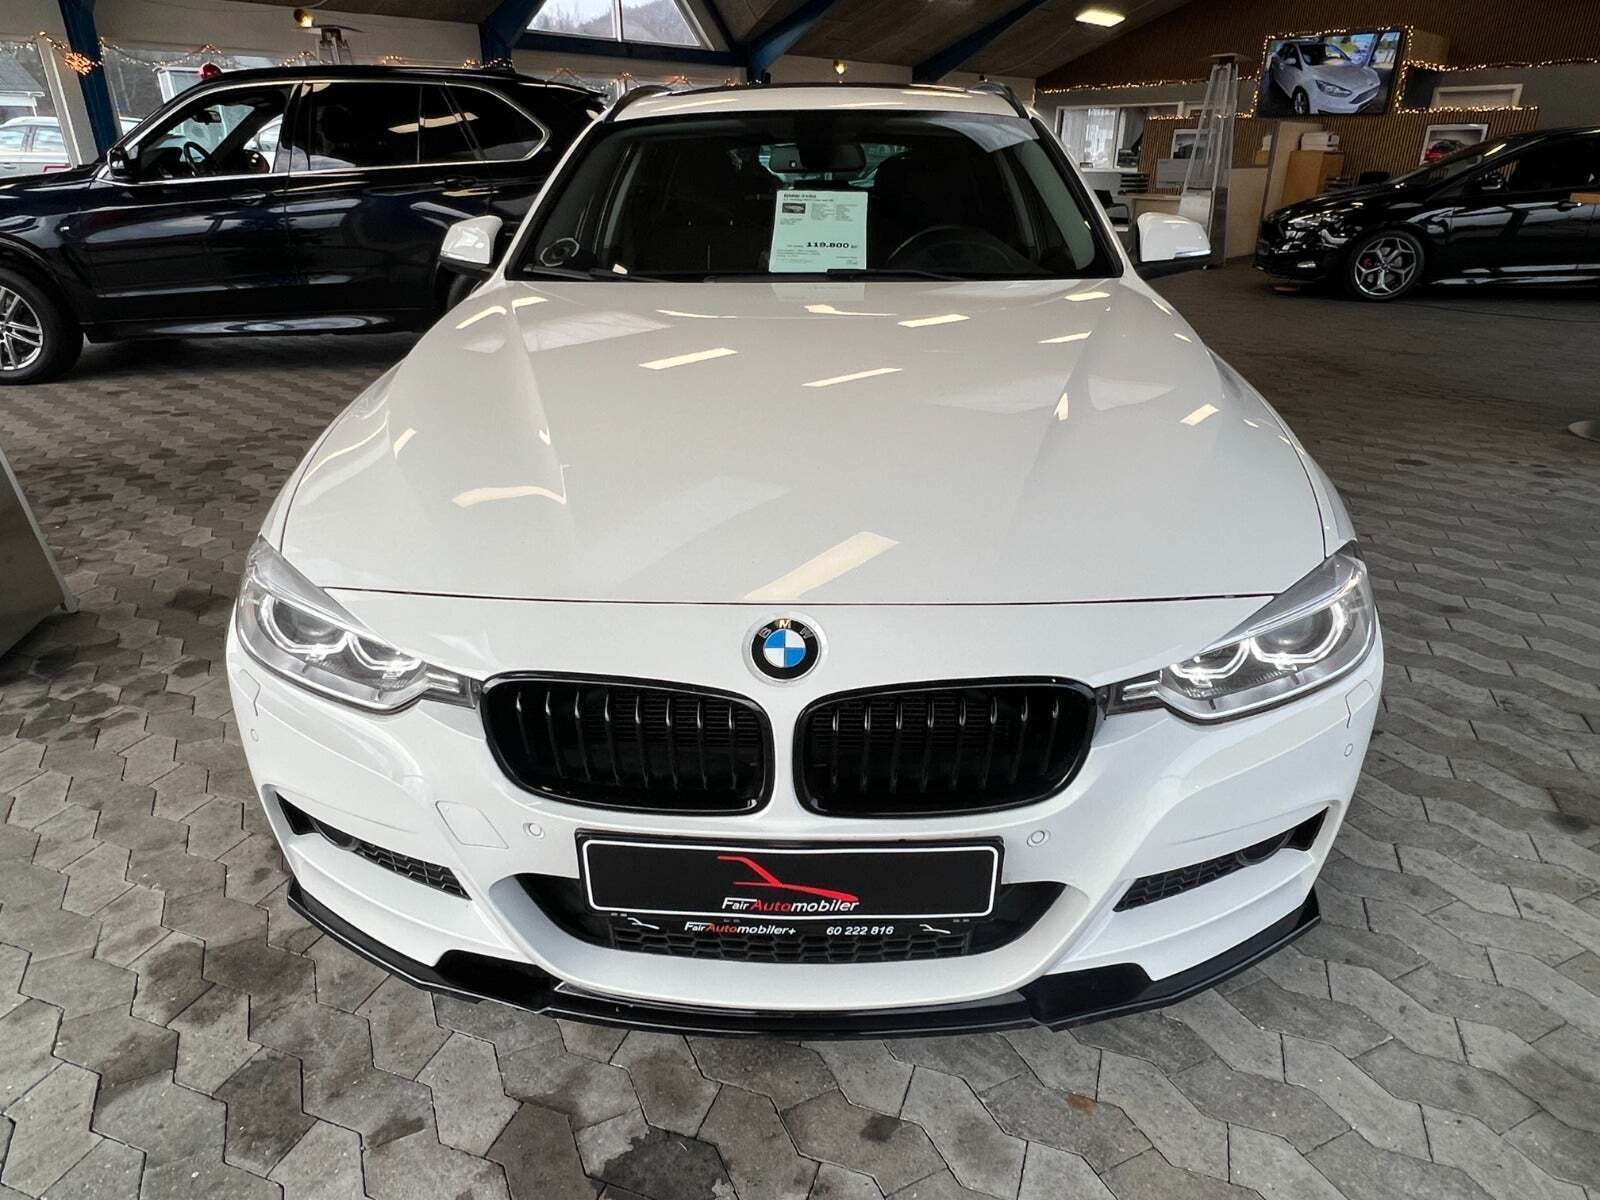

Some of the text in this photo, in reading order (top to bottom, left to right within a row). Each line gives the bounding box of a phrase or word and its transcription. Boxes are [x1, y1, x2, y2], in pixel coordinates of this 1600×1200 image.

[759, 619, 814, 639] BMW
[826, 926, 843, 935] 60
[844, 926, 868, 935] 222
[870, 926, 895, 935] 816
